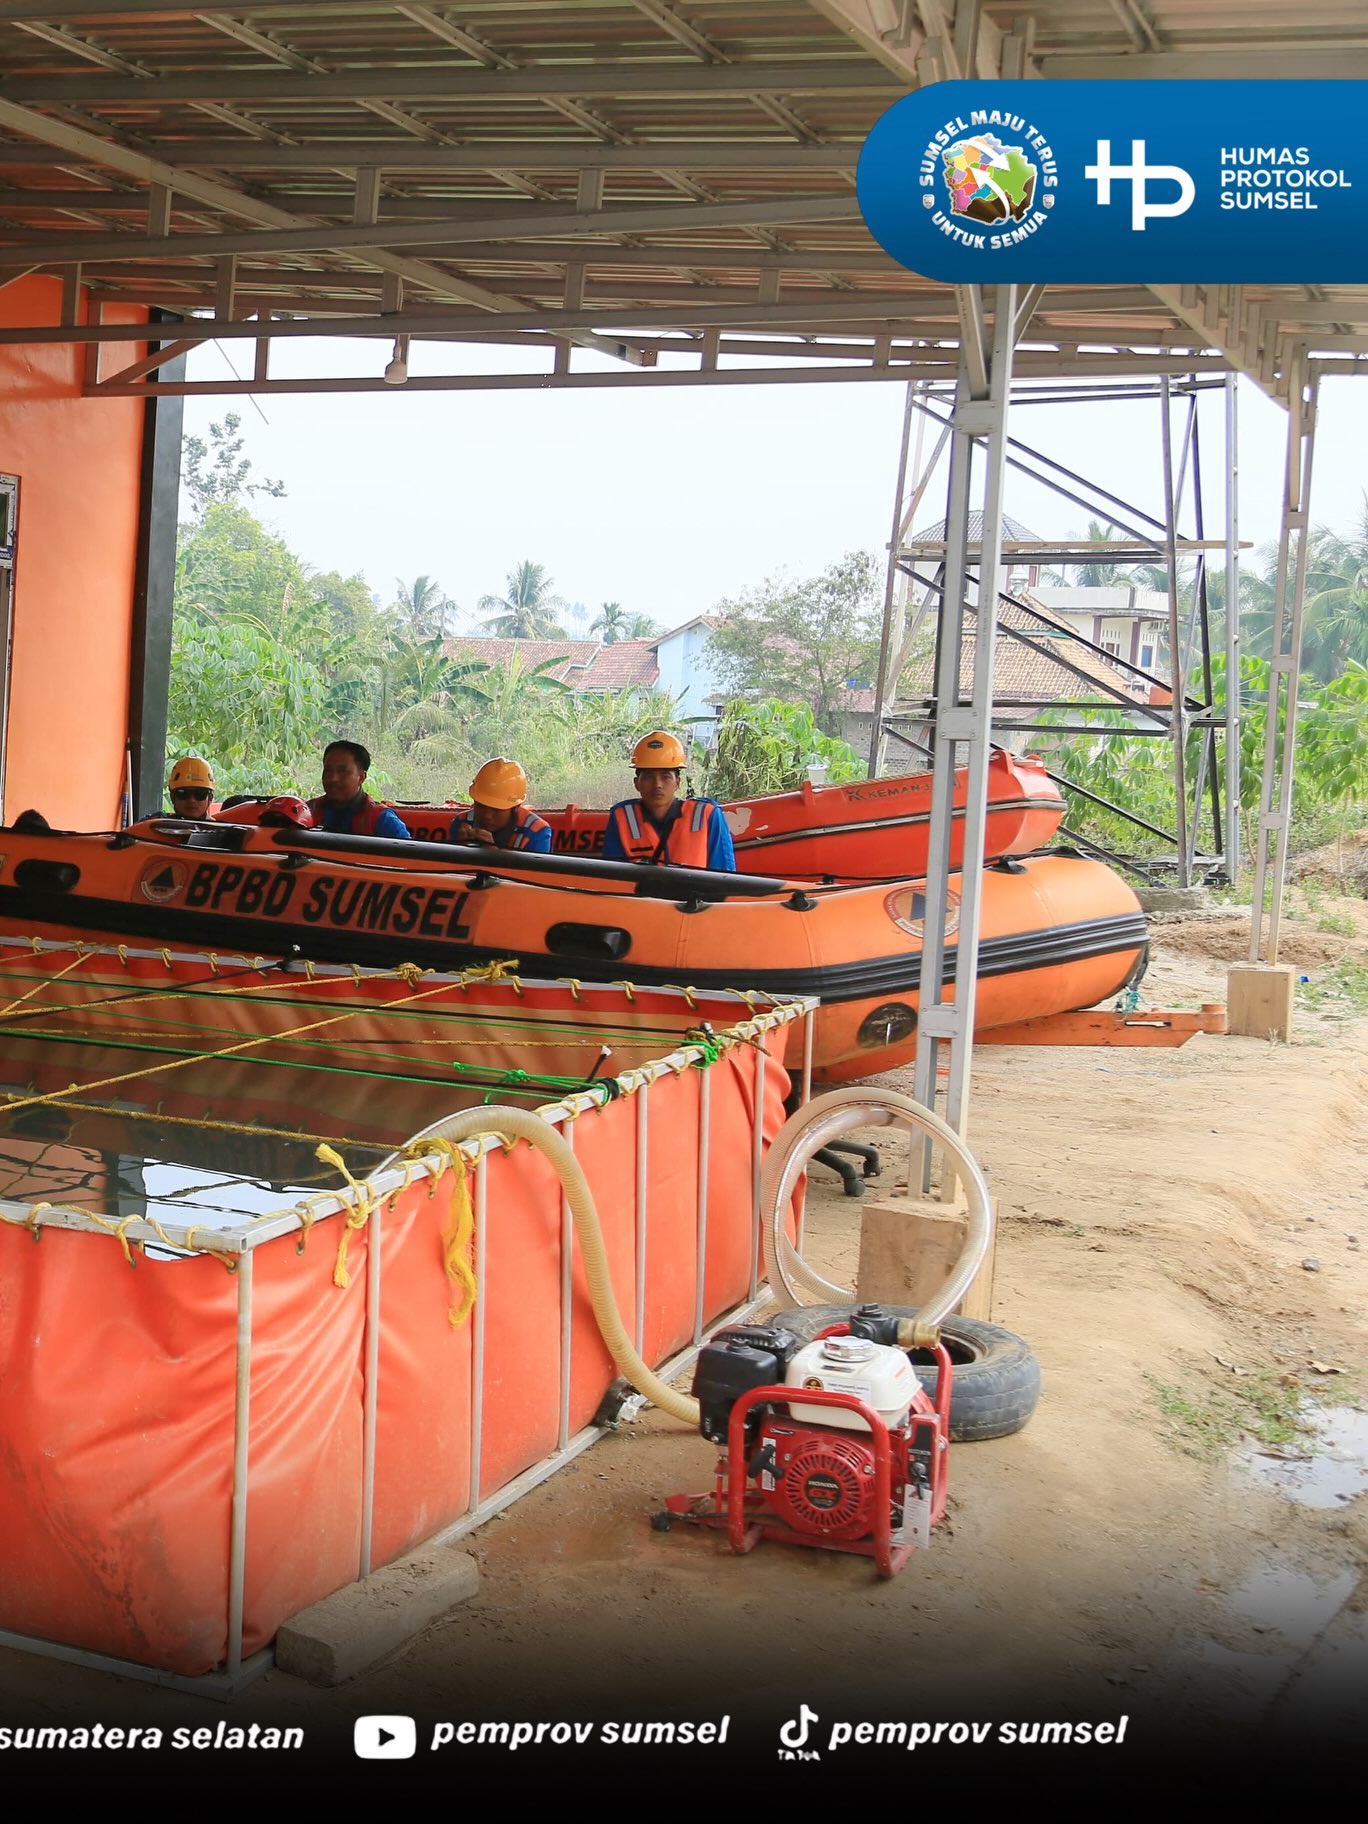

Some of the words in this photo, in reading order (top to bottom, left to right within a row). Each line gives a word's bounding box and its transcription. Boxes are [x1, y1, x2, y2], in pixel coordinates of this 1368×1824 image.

[184, 862, 297, 916] BPBD
[301, 875, 470, 939] SUMSEL
[807, 1480, 839, 1489] HONDA
